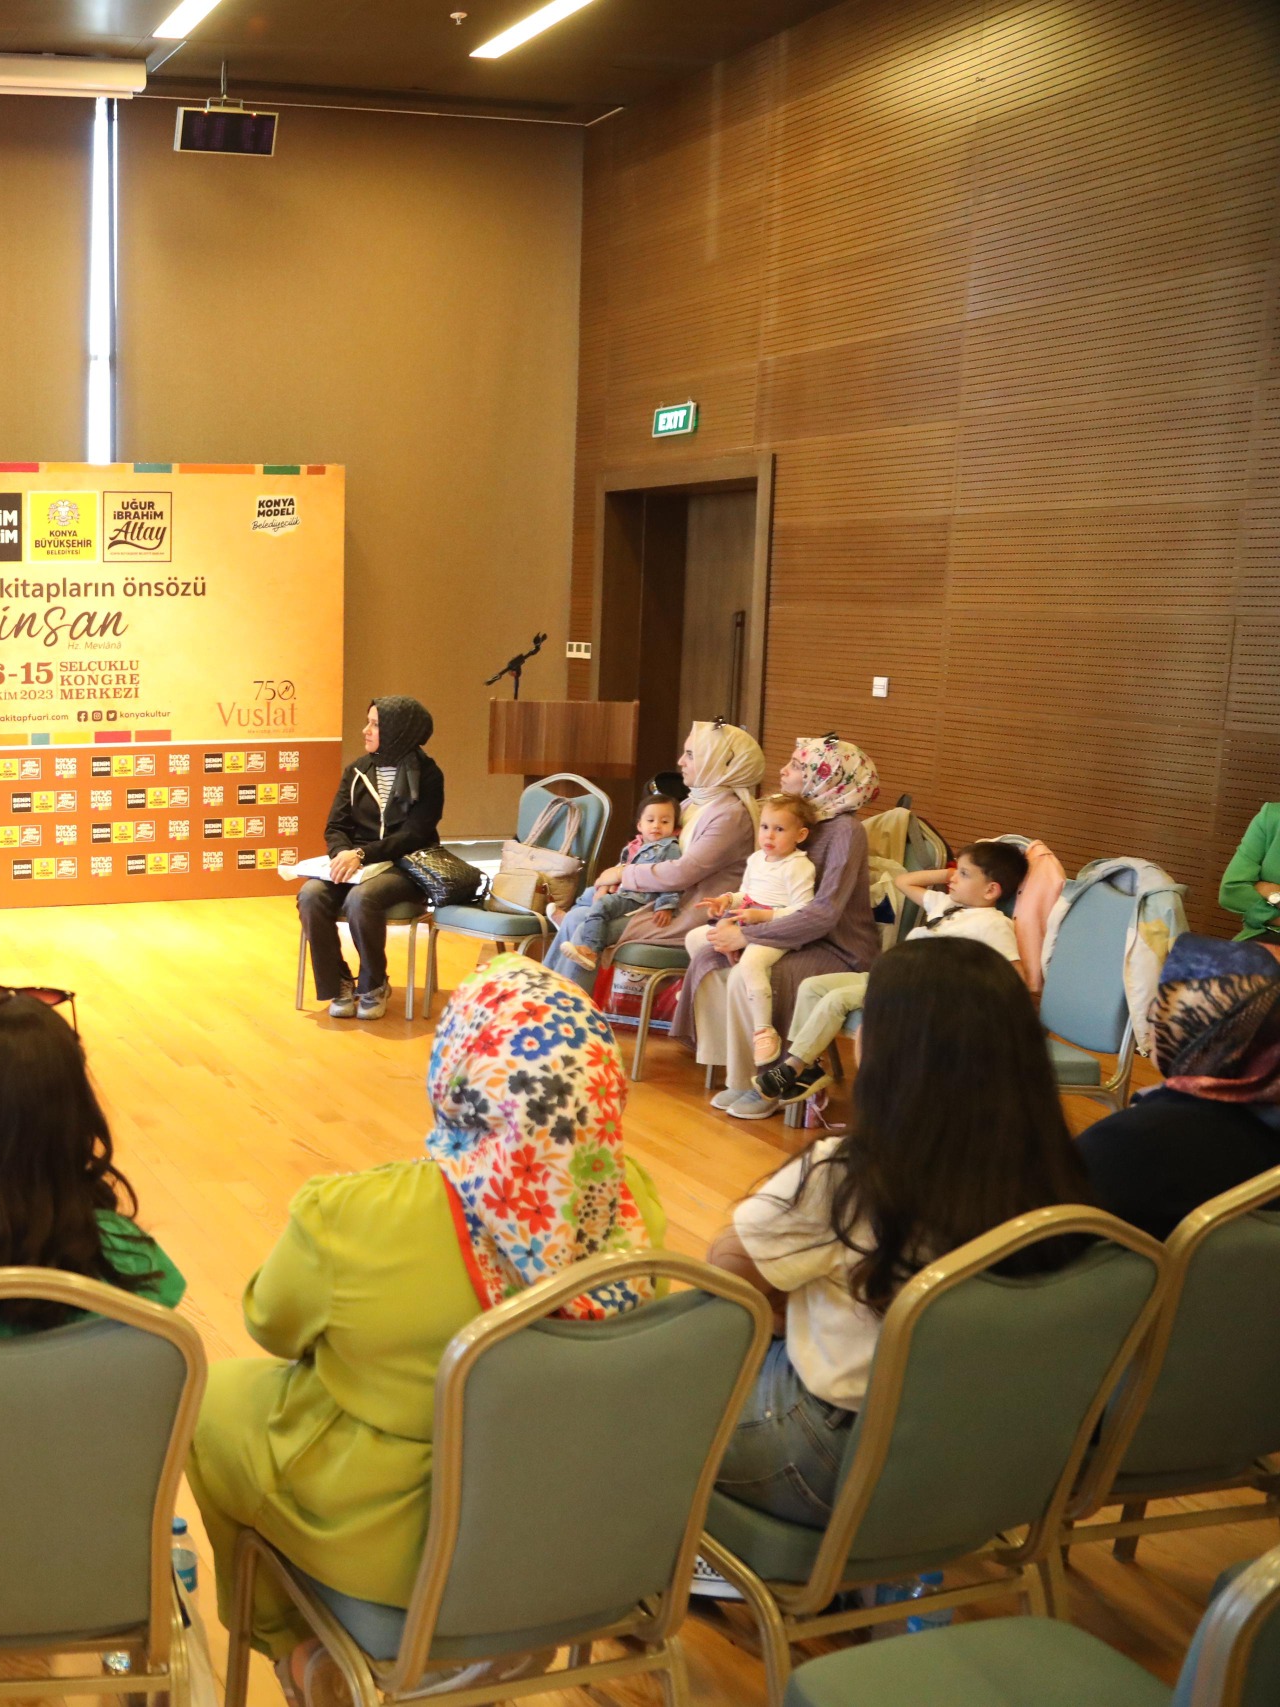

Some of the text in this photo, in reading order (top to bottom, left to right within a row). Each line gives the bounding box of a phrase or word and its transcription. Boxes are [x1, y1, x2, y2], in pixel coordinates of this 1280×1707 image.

[658, 410, 687, 431] EXIT
[121, 499, 155, 510] UĞUR
[258, 498, 295, 508] KONYA
[108, 520, 167, 550] Altay
[34, 538, 92, 549] BÜYÜKŞEHİR
[0, 577, 115, 603] kitapların
[123, 577, 207, 597] önsözü
[68, 642, 81, 650] Hz.
[59, 660, 140, 673] SELÇUKLU
[60, 674, 140, 686] KONGRE
[20, 689, 54, 700] 2023
[60, 685, 140, 700] MERKEZİ
[119, 710, 171, 720] konyakultur
[216, 701, 298, 727] Vuslat
